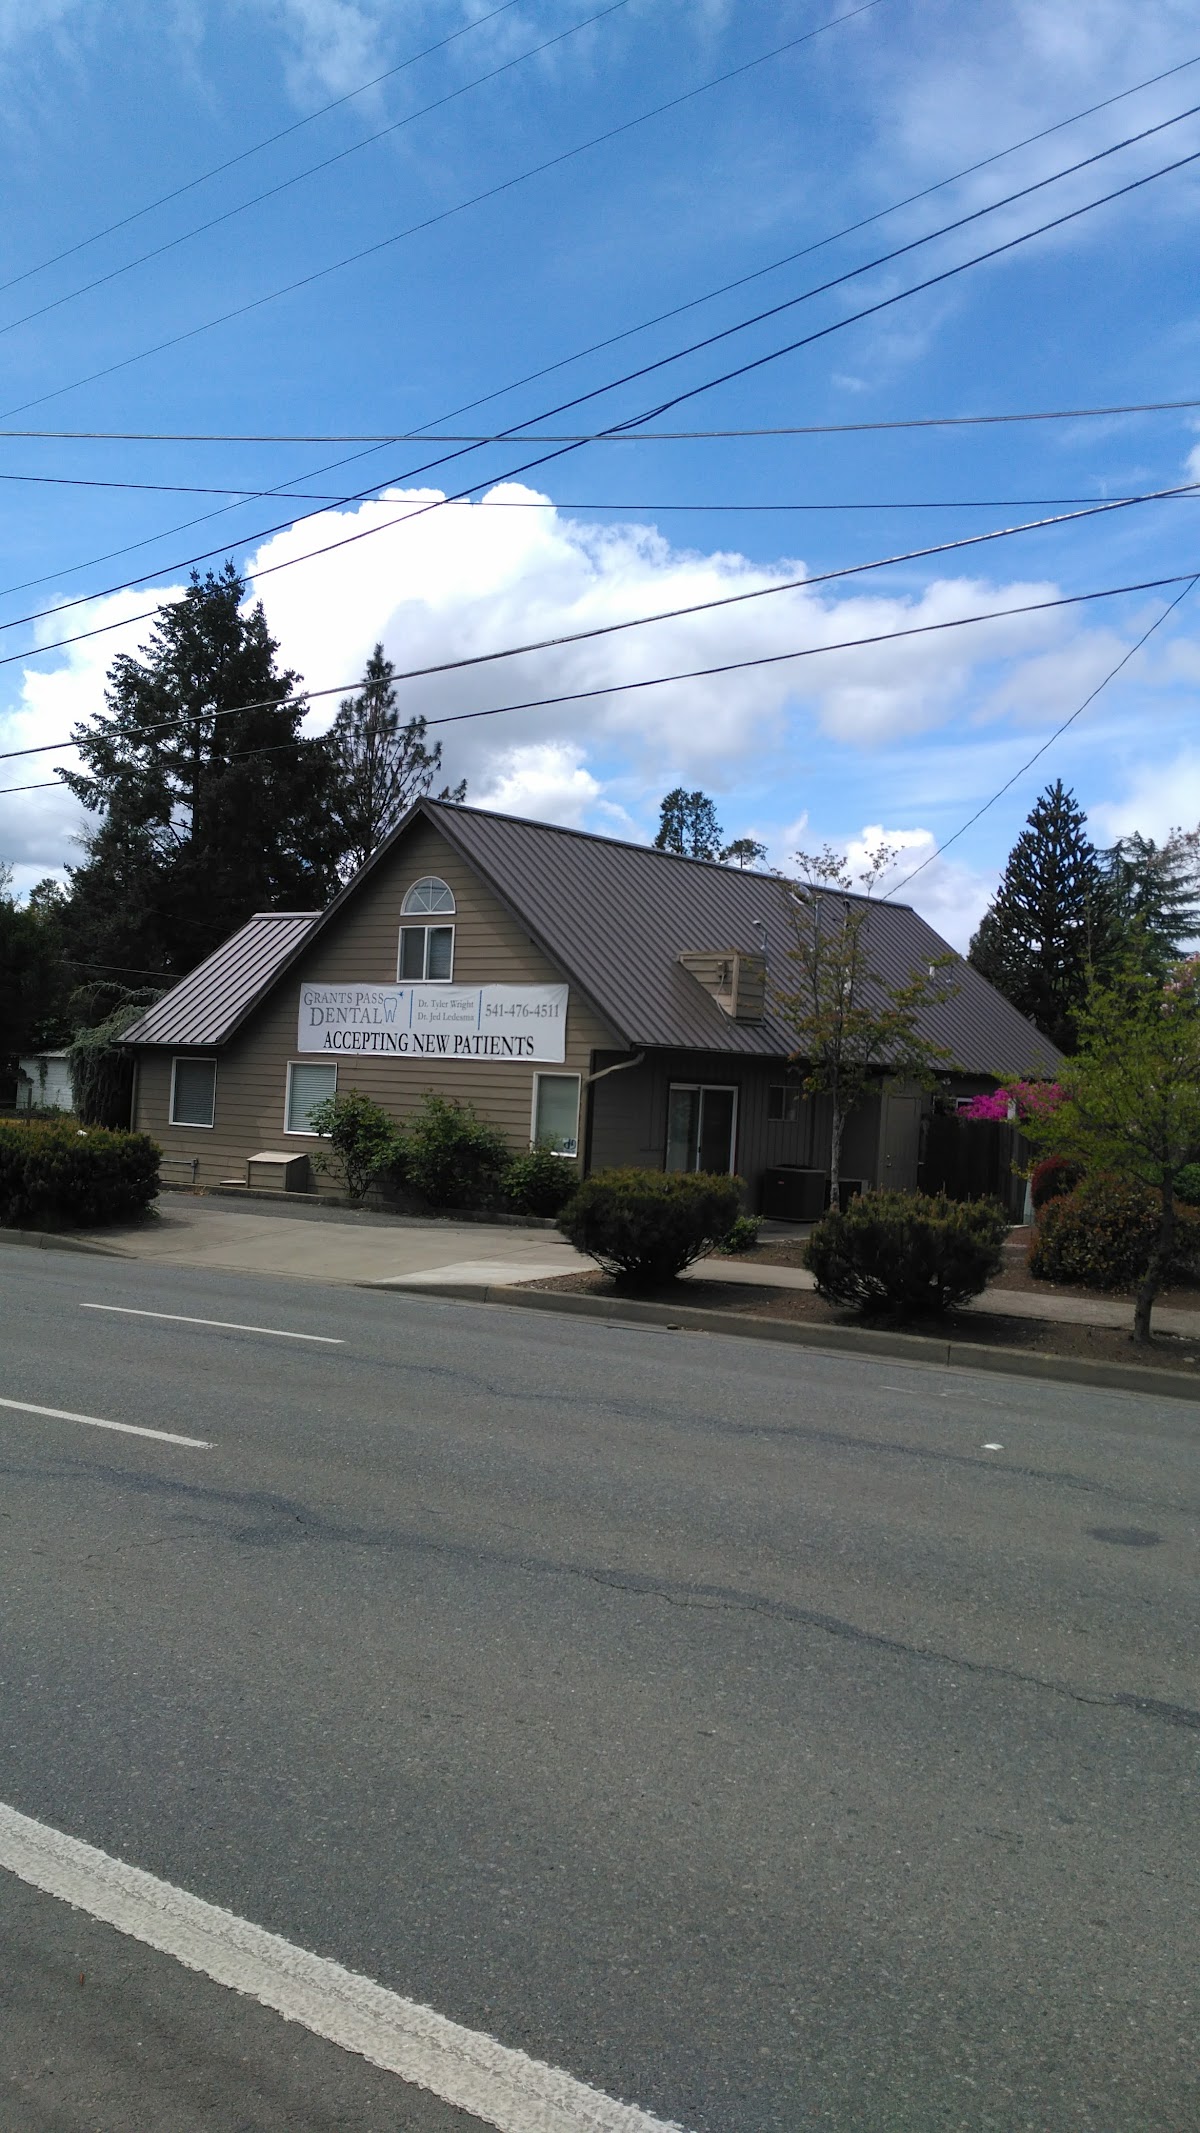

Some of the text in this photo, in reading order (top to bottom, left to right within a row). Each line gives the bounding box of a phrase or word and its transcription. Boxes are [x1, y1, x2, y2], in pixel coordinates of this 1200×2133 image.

[304, 992, 384, 1006] GRANTS PASS
[418, 1000, 474, 1010] Dr. Tyler Wright
[310, 1007, 382, 1026] DENTAL
[417, 1012, 474, 1023] Dr. Jed Ledesma
[485, 1004, 560, 1018] 541-476-4511
[323, 1031, 534, 1056] ACCEPTING NEW PATIENTS
